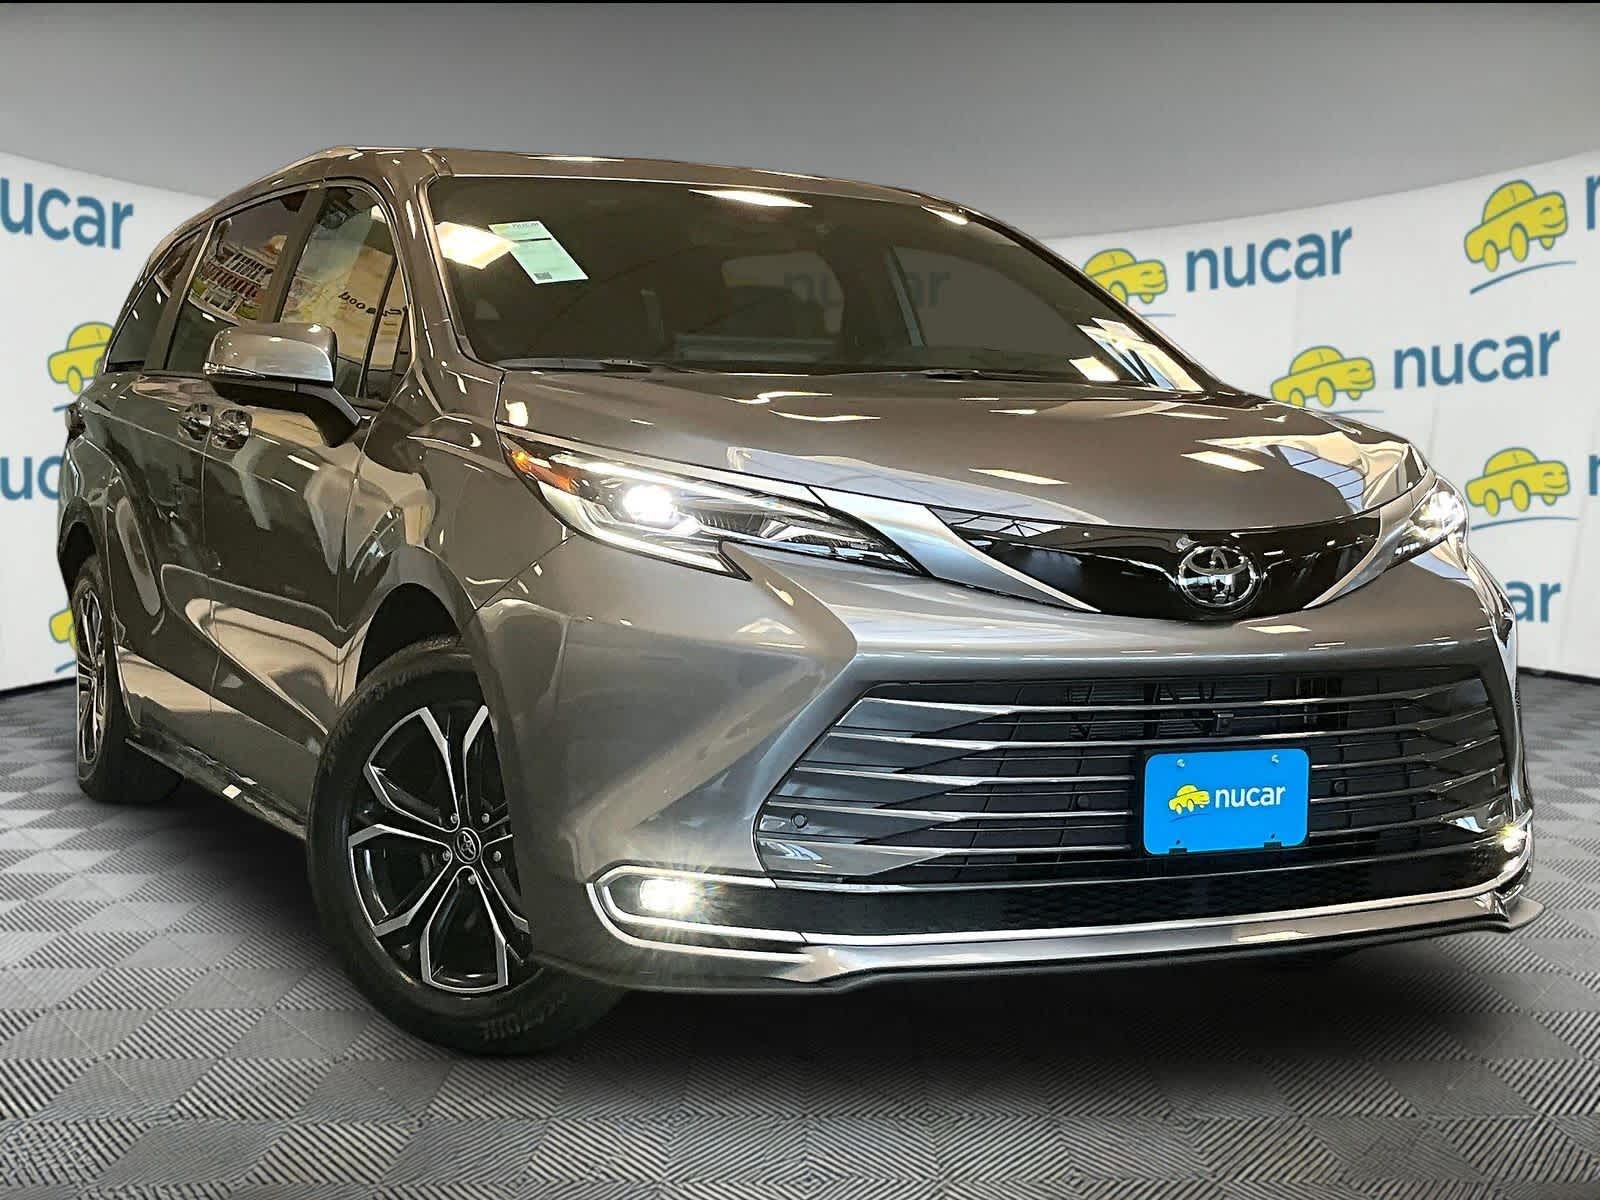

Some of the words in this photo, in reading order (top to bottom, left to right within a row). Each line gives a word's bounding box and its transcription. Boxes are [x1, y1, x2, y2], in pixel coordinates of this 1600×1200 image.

[0, 177, 134, 250] ucar
[1186, 226, 1352, 292] nucar
[1394, 330, 1560, 389] nucar
[1215, 786, 1286, 808] nucar
